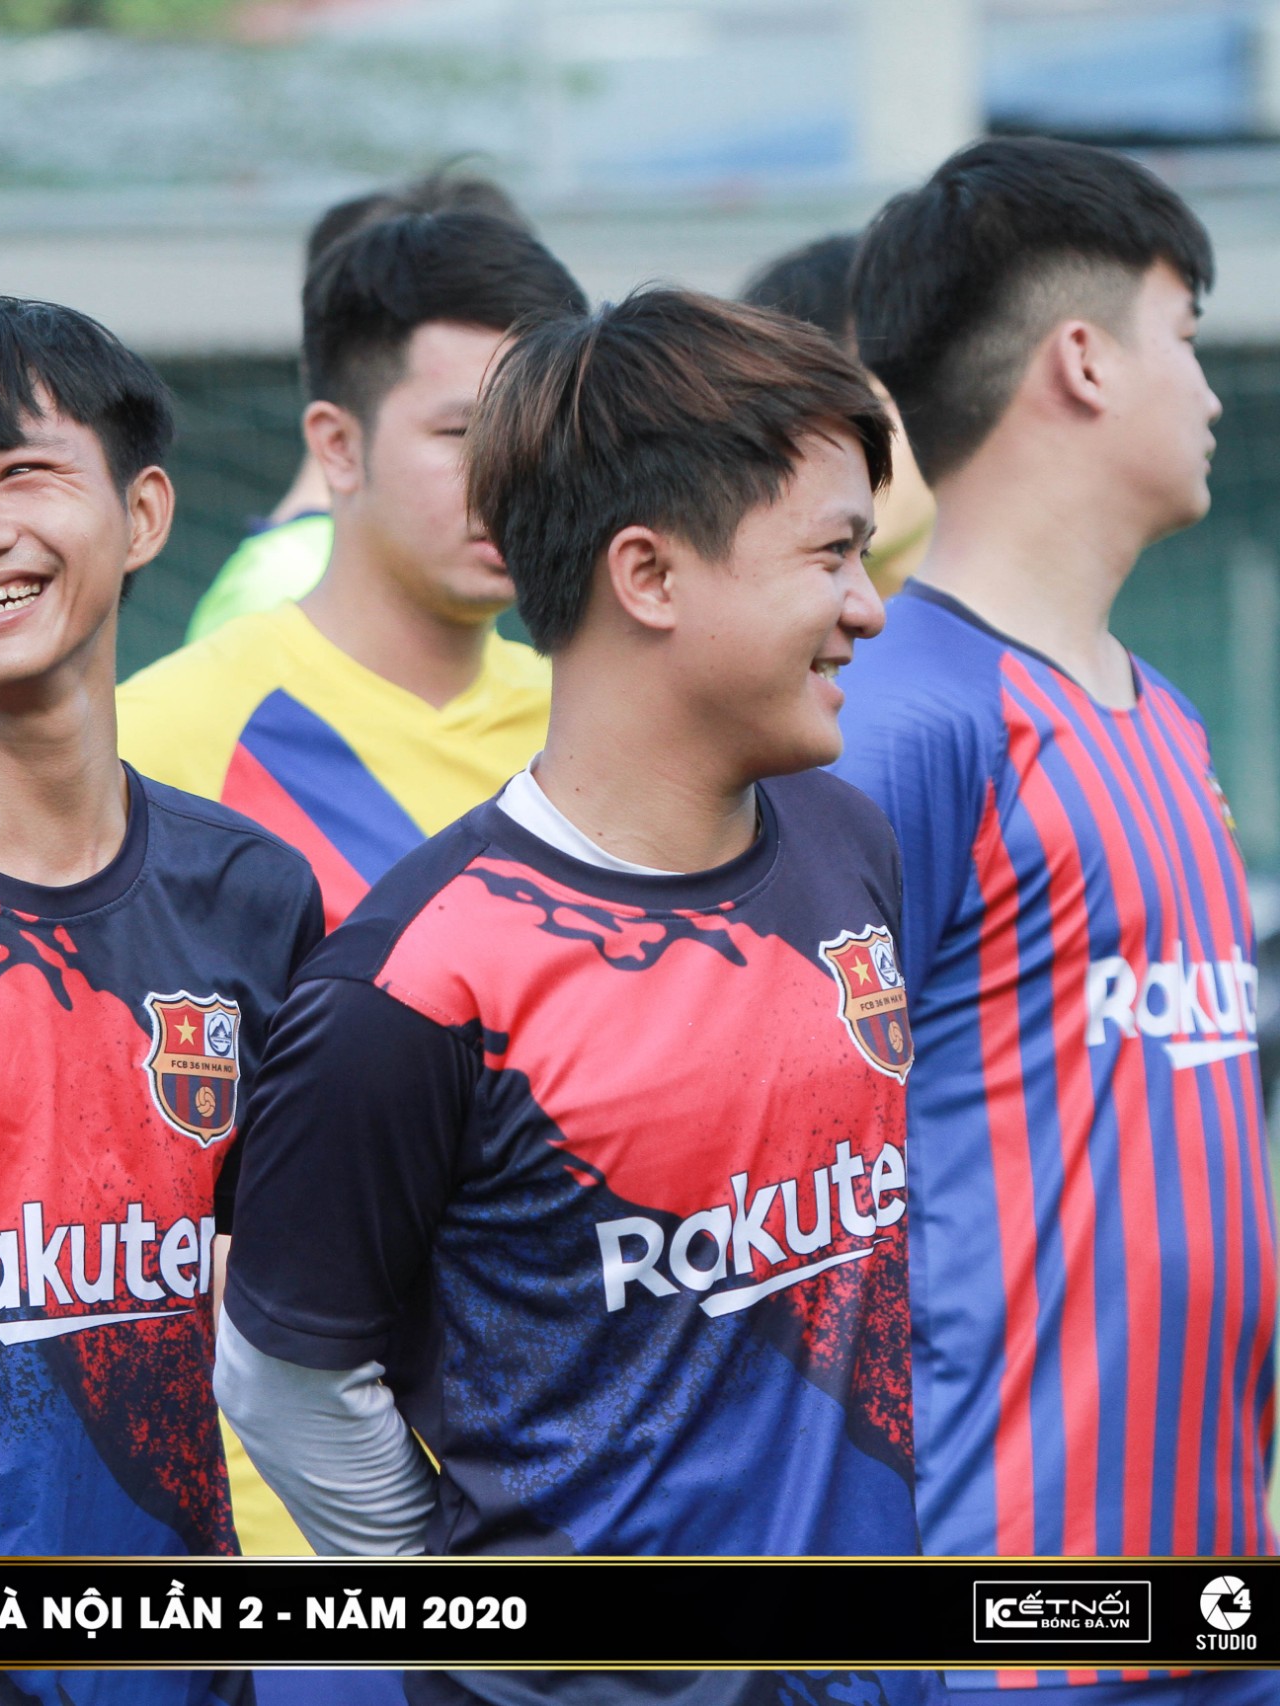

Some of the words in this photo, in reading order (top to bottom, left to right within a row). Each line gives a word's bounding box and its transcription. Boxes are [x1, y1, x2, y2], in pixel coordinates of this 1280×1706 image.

[860, 1001, 875, 1011] FCB
[875, 998, 883, 1007] 36
[1085, 939, 1259, 1047] Rakut
[171, 1060, 188, 1069] FCB
[189, 1061, 200, 1070] 36
[201, 1062, 210, 1071] IN
[211, 1063, 223, 1072] HA
[596, 1139, 908, 1313] Rakute
